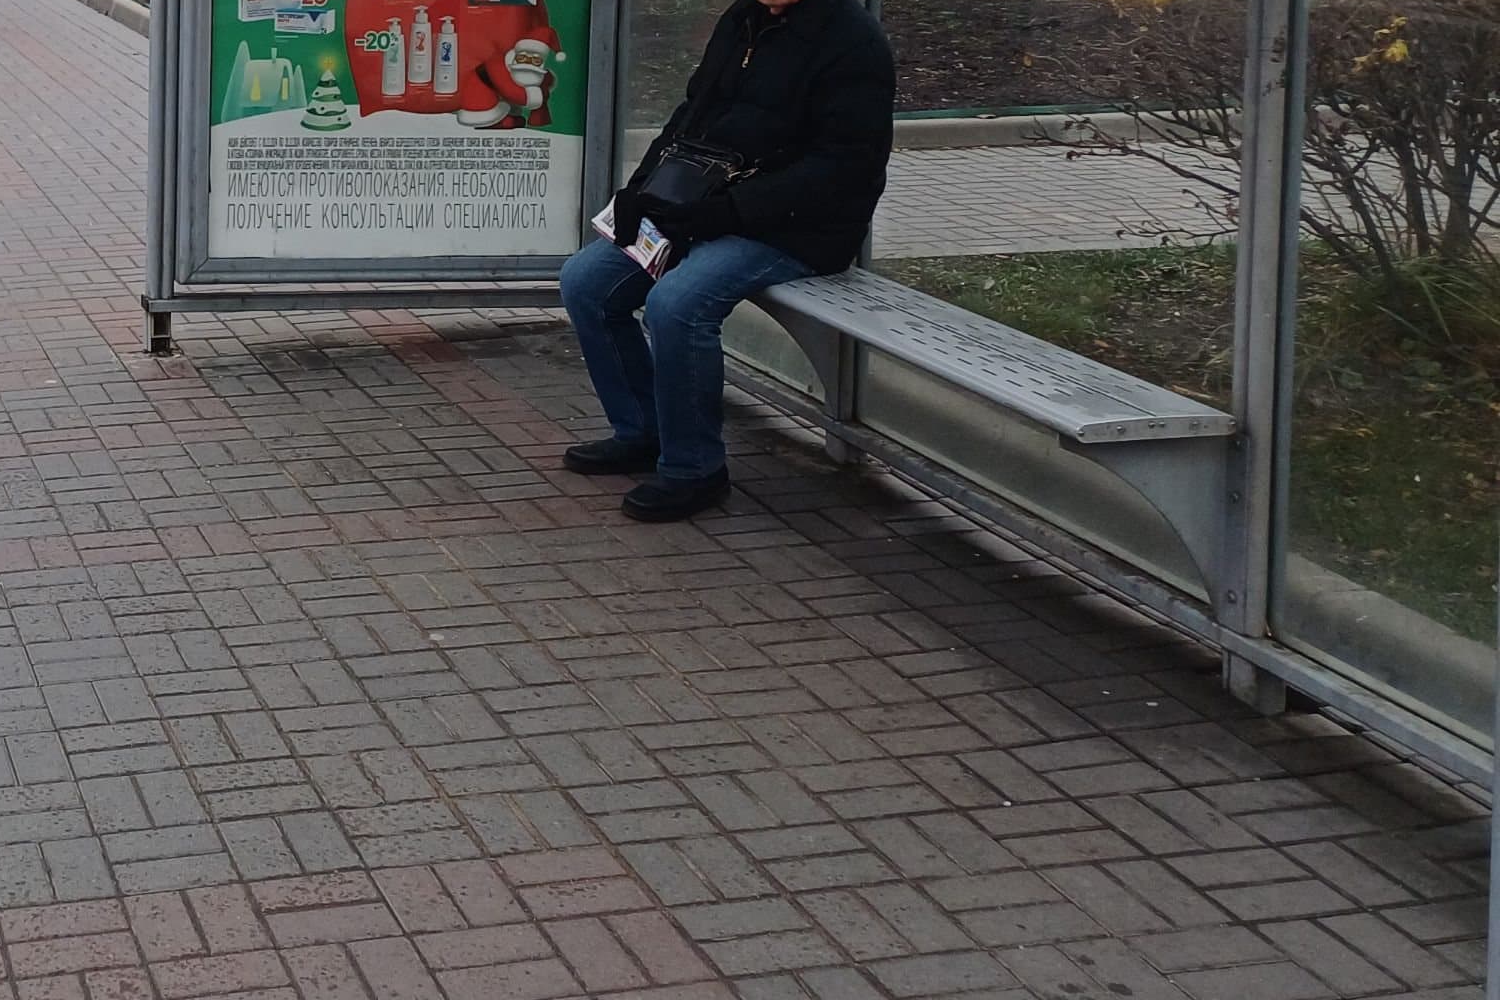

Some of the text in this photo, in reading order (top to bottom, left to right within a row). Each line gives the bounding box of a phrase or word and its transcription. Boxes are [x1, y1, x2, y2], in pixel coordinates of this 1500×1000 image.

[228, 171, 548, 200] ИМЕЮТСЯ ПРОТИВОПОКАЗАНИЯ. НЕОБХОДИМО
[227, 202, 547, 231] ПОЛУЧЕНИЕ КОНСУЛЬТАЦИИ СПЕЦИАЛИСТА
